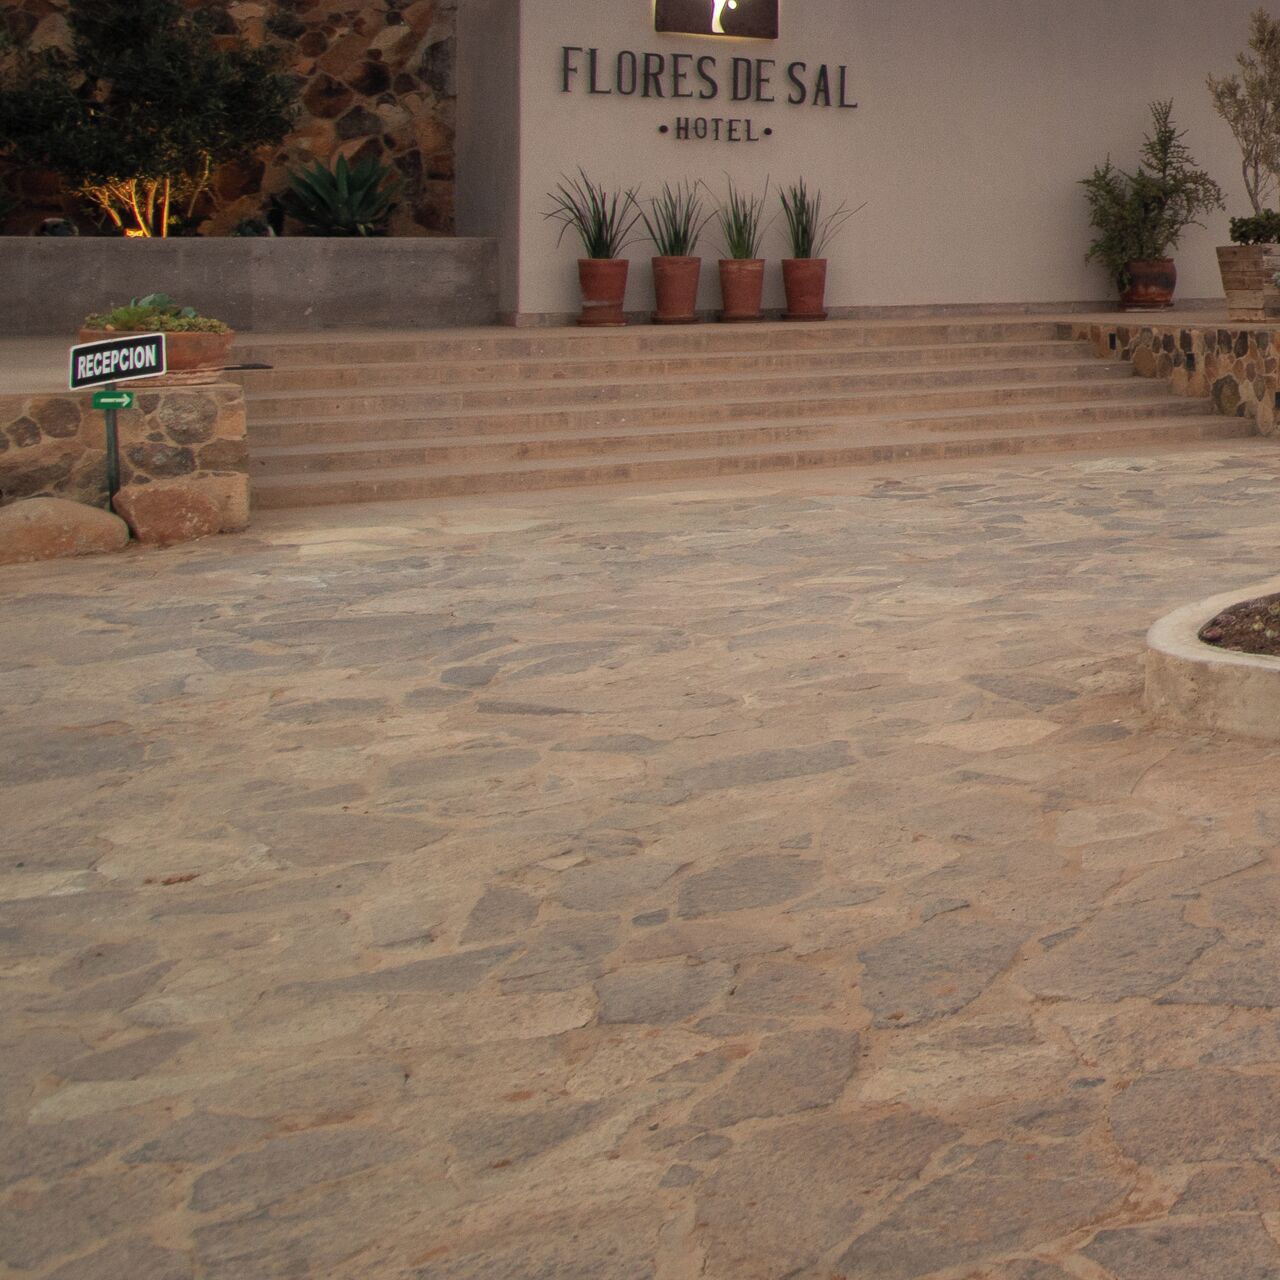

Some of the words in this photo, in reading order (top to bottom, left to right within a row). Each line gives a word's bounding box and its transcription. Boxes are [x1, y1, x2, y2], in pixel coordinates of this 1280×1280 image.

[560, 46, 718, 100] FLORES
[731, 57, 775, 102] DE
[787, 61, 858, 108] SAL
[675, 117, 760, 142] HOTEL
[78, 344, 157, 379] RECEPCION
